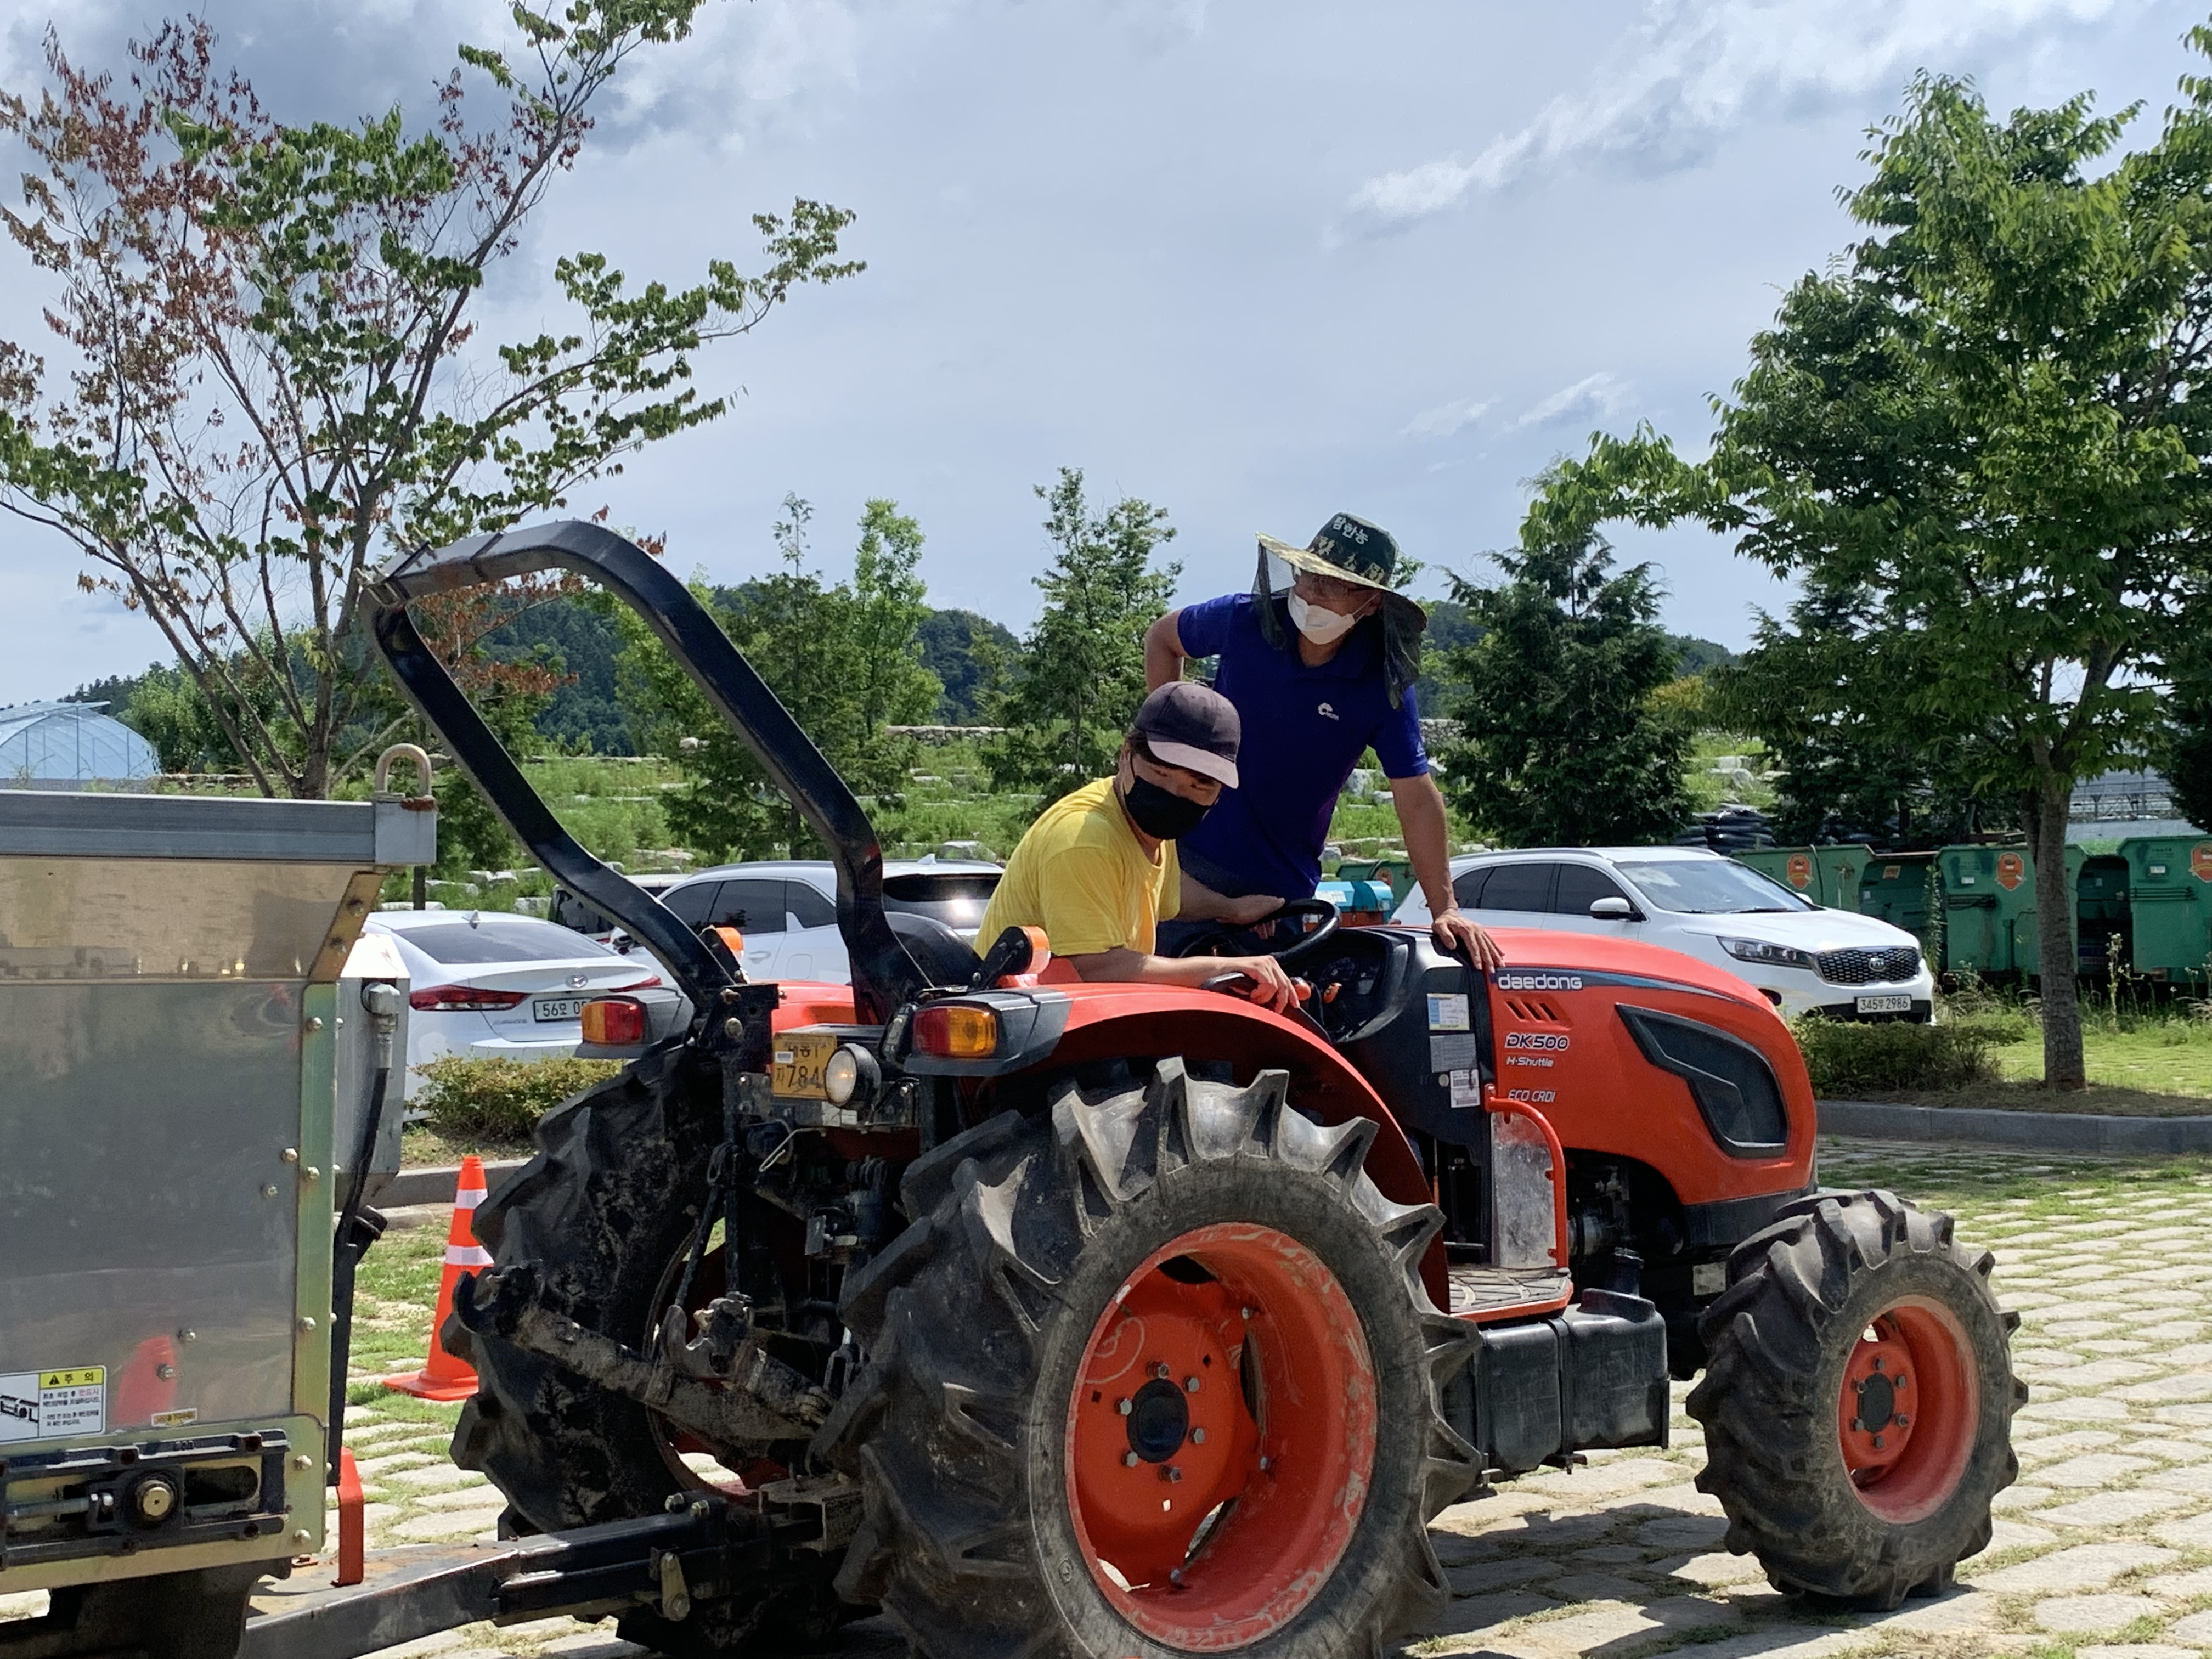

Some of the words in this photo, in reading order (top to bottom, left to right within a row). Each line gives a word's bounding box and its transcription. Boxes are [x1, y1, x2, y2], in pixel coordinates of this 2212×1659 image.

[1333, 517, 1368, 544] 팜한농
[1498, 974, 1582, 990] daedong
[543, 1003, 567, 1017] 56모
[1886, 998, 1908, 1009] 2986
[1505, 1032, 1570, 1050] DK500
[1506, 1056, 1554, 1067] H-Shuttle
[787, 1065, 826, 1088] 784
[1509, 1089, 1530, 1102] ECO
[1531, 1090, 1556, 1103] CRDI
